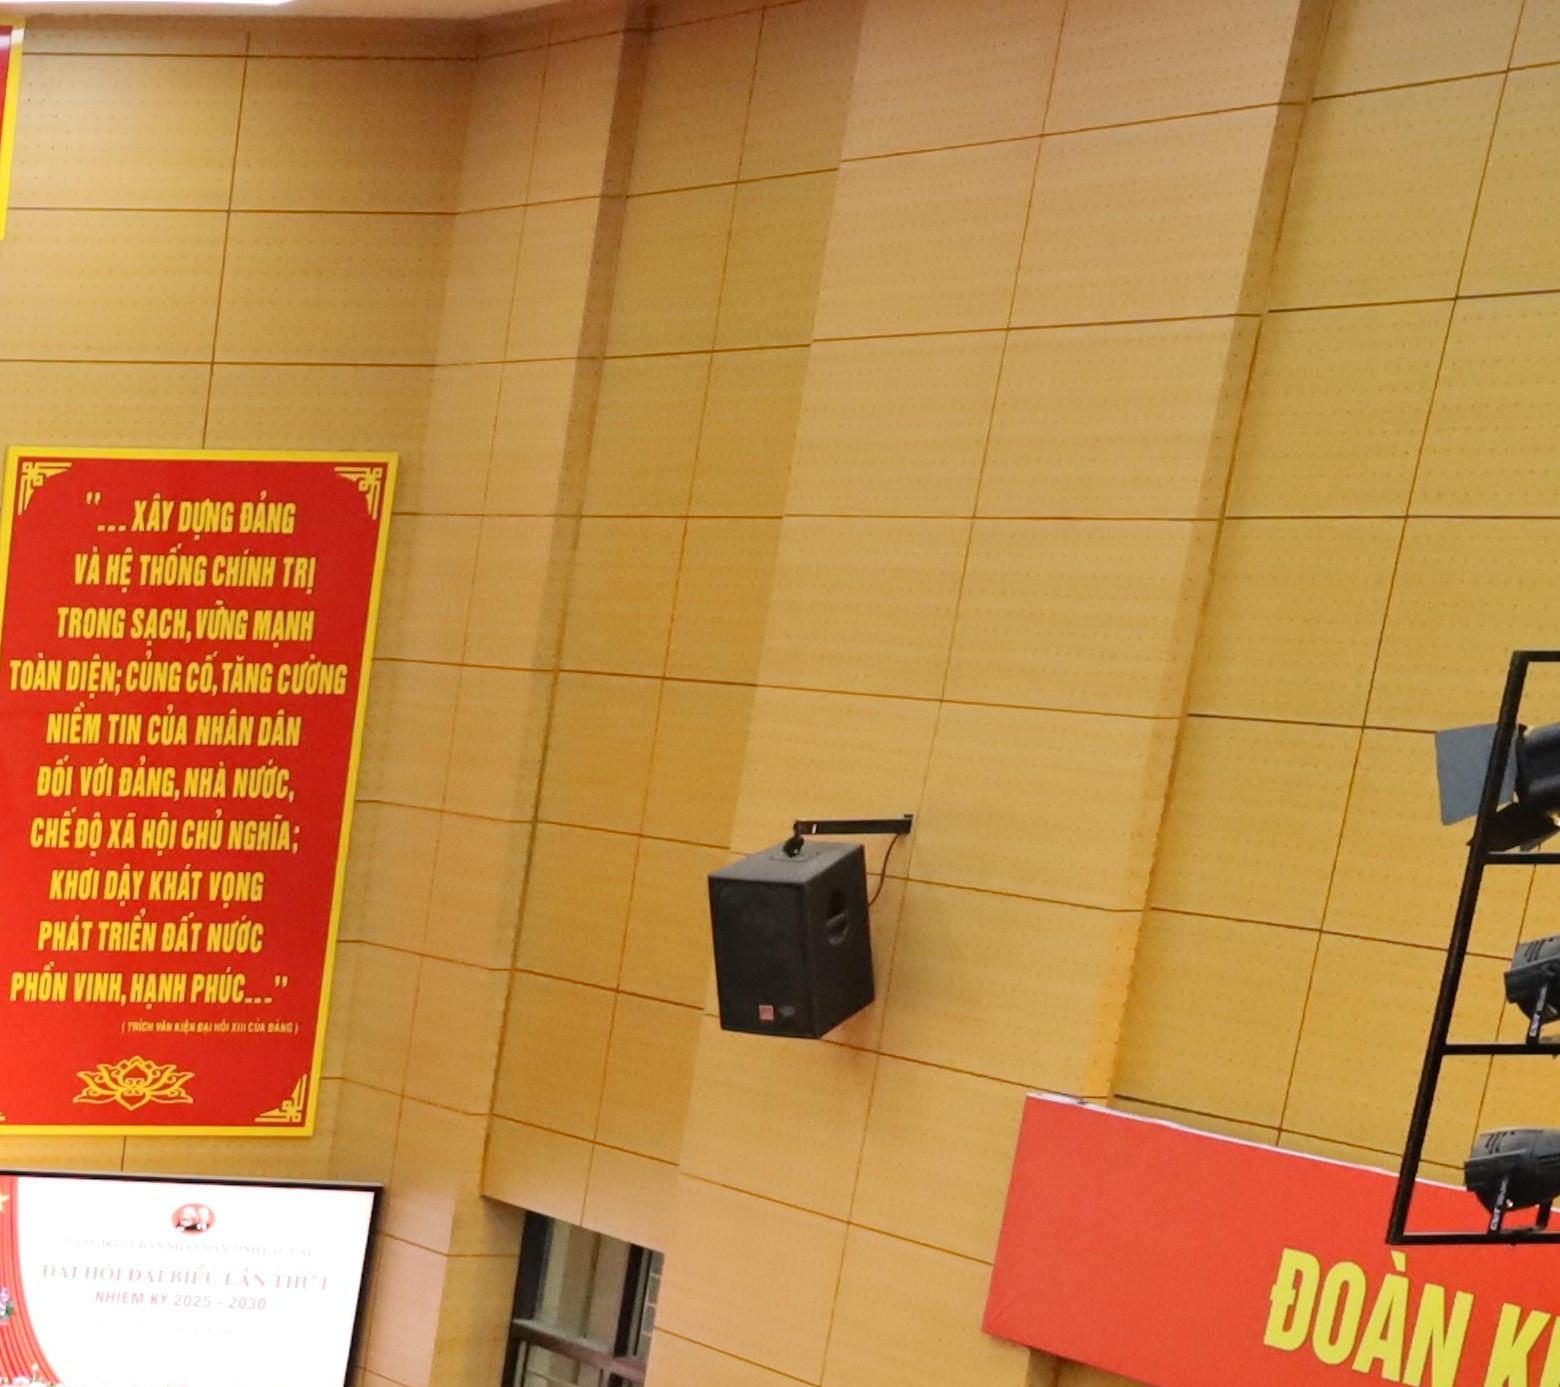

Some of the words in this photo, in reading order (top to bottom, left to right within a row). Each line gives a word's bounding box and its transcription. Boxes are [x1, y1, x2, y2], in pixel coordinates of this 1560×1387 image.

[131, 493, 174, 532] XÂY
[177, 498, 235, 541] DỰNG
[239, 490, 296, 534] ĐẢNG
[74, 546, 100, 585] VÀ
[105, 546, 134, 593] HỆ
[139, 543, 208, 587] THỐNG
[211, 549, 276, 587] CHÍNH
[283, 556, 316, 594] TRỊ
[57, 607, 126, 639] TRONG
[195, 600, 249, 641] VỮNG
[252, 610, 315, 648] MẠNH
[46, 701, 102, 744] NIỀM
[108, 713, 143, 745] TIN
[147, 704, 188, 746] CỦA
[195, 708, 254, 746] NHÂN
[257, 709, 302, 746] DÂN
[49, 867, 100, 901] KHƠI
[103, 863, 145, 907] DẬY
[148, 863, 203, 901] KHÁT
[209, 871, 264, 909] VỌNG
[37, 914, 94, 951] PHÁT
[98, 908, 157, 952] TRIỂN
[161, 911, 203, 952] ĐẤT
[206, 915, 264, 953] NƯỚC
[9, 961, 69, 1002] PHỒN
[129, 973, 187, 1010] HẠNH
